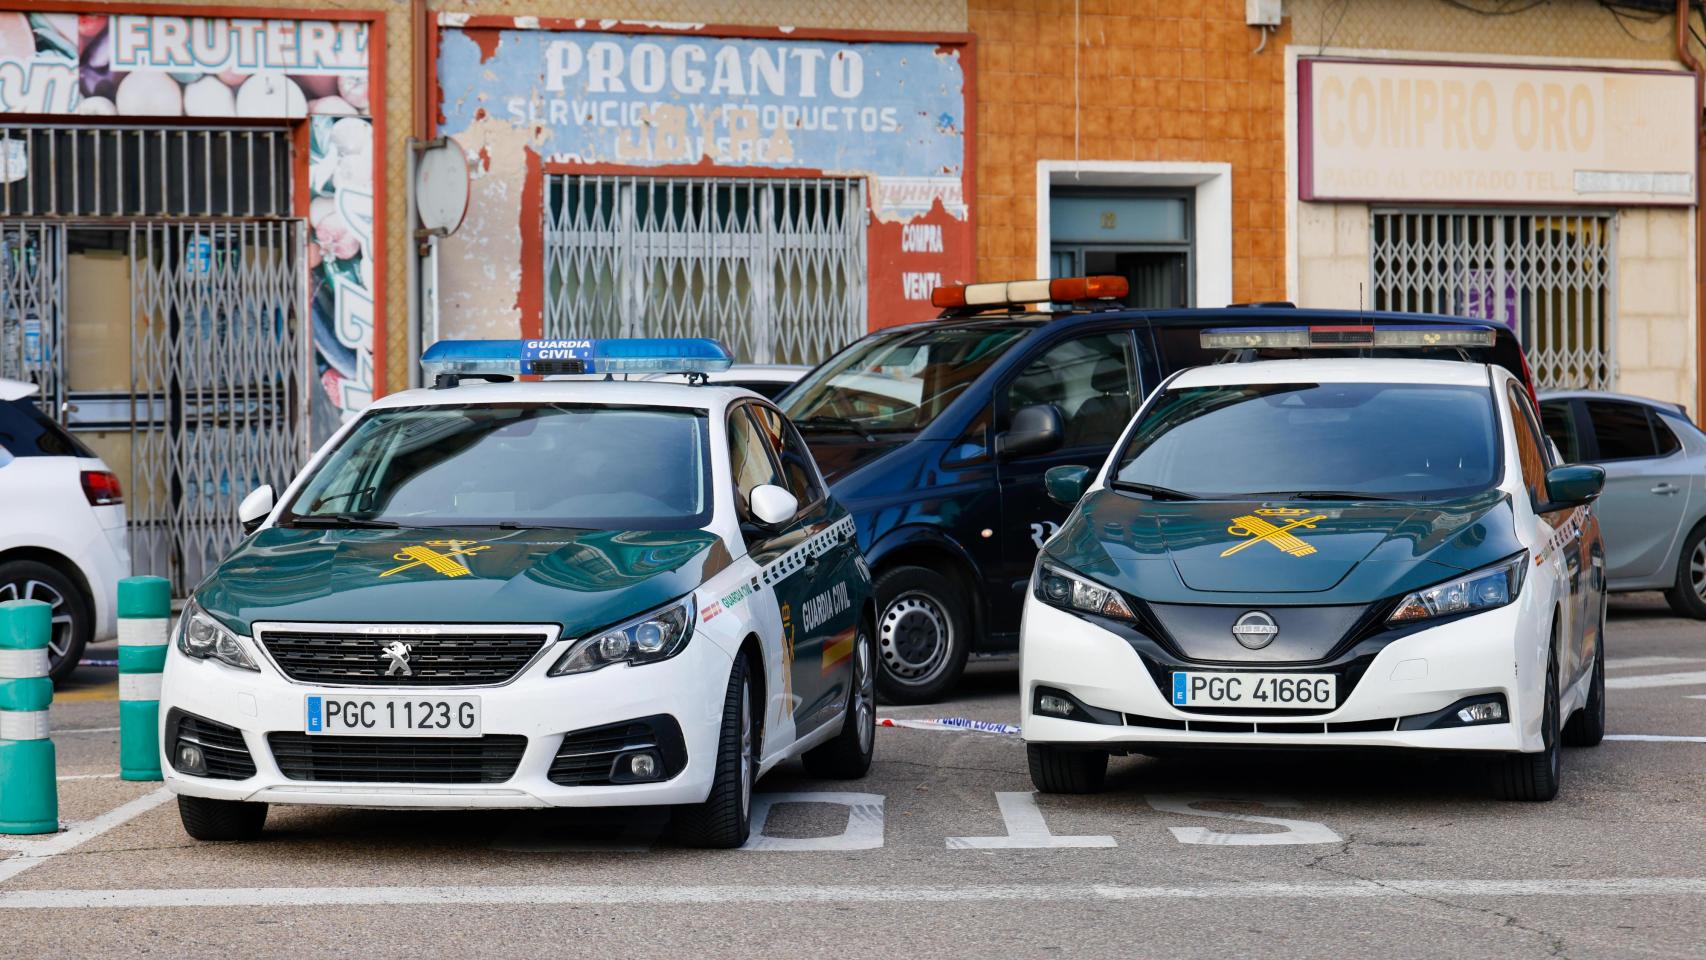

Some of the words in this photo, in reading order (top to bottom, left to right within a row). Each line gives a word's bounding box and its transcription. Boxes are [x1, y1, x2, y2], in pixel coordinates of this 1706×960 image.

[116, 18, 369, 69] FRUTERI
[545, 40, 865, 98] PROGANTO
[1319, 75, 1497, 151] COMPRO
[1512, 80, 1596, 152] ORO
[1419, 169, 1517, 191] CONTADO
[902, 224, 943, 253] COMPRA
[527, 341, 591, 349] GUARDIA
[538, 349, 577, 359] CIVIL
[721, 587, 744, 609] GUARDIA
[802, 594, 834, 633] GUARDIA
[832, 581, 851, 615] CIVIL
[1233, 625, 1278, 633] NISSAN
[1177, 691, 1183, 699] E
[1191, 676, 1242, 702] PGC
[1252, 677, 1330, 703] 4166G
[312, 717, 318, 726] E
[326, 700, 376, 728] PGC
